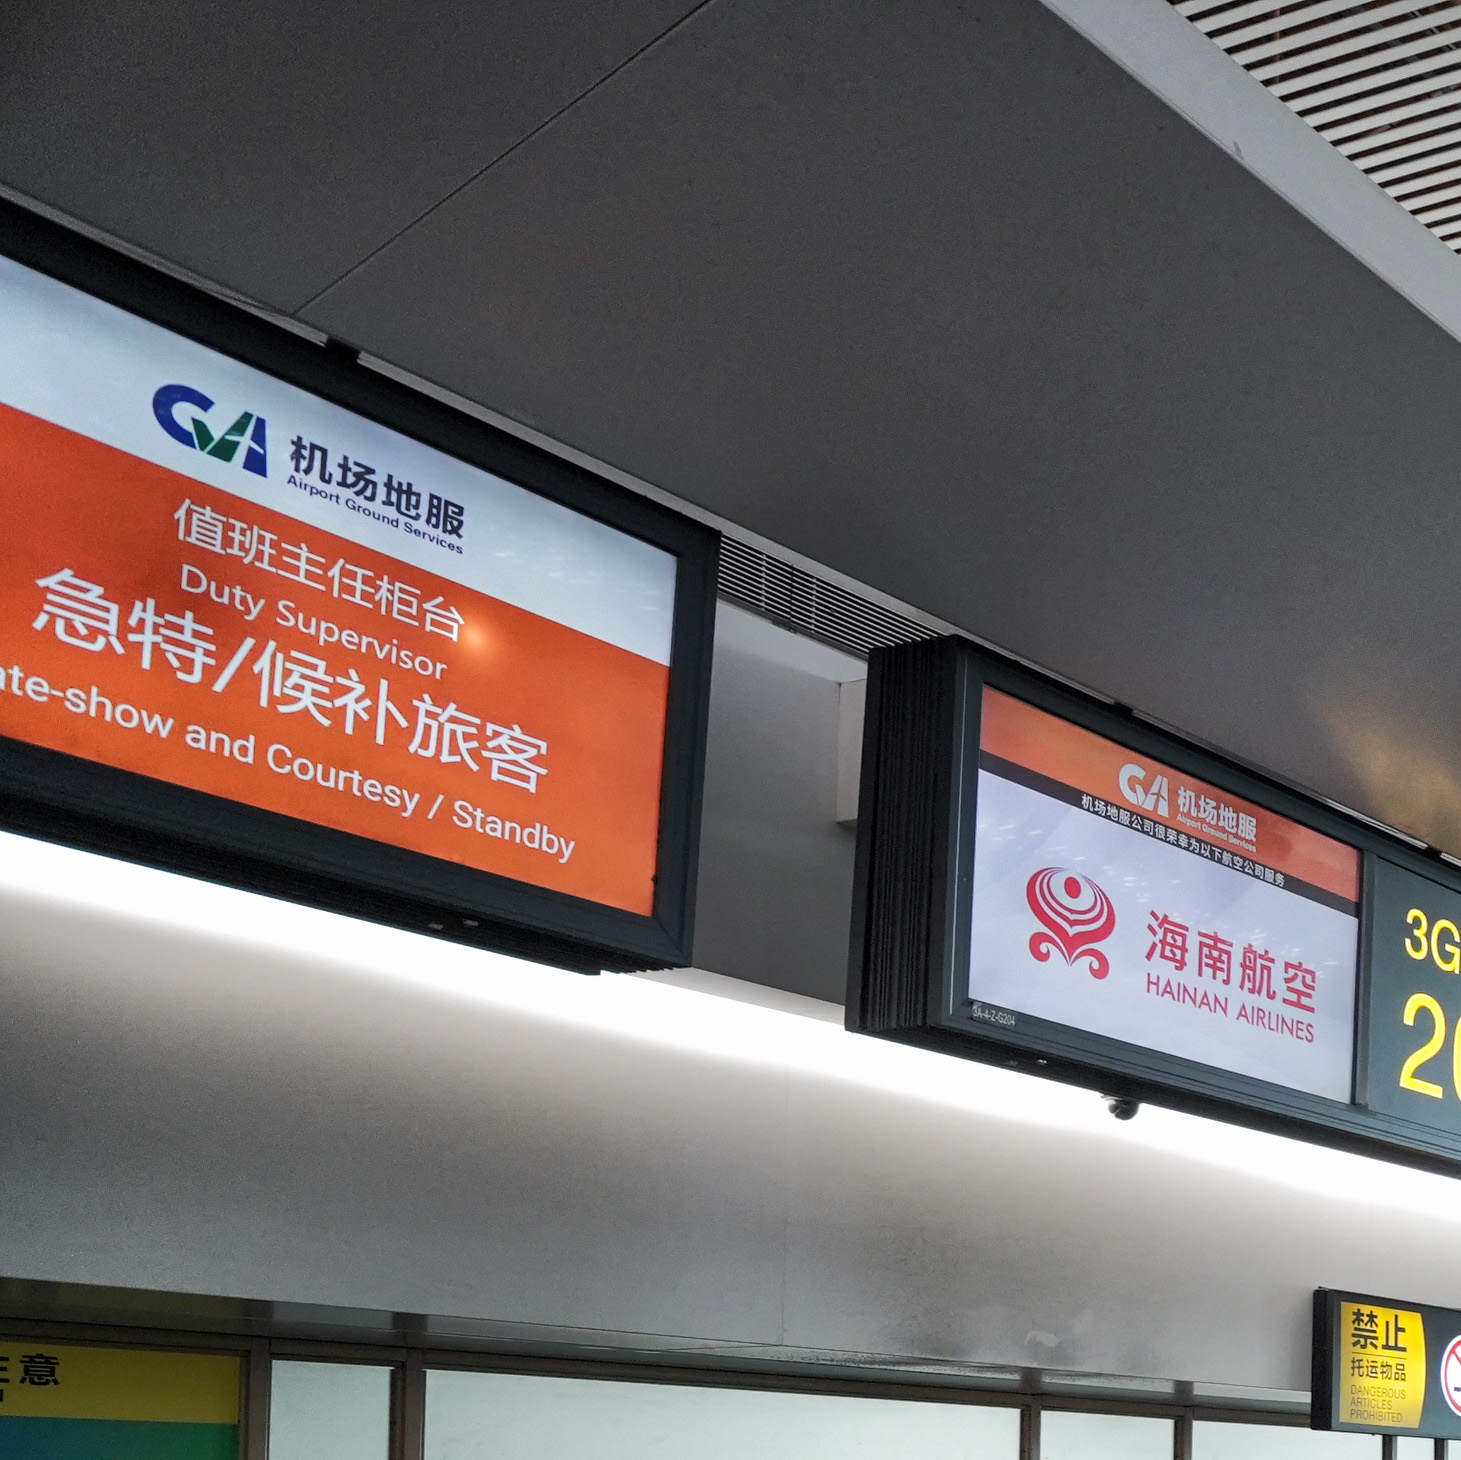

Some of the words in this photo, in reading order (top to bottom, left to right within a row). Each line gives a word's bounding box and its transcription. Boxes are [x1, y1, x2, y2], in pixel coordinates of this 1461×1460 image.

[287, 474, 341, 505] Airport
[345, 498, 399, 529] Ground
[404, 521, 464, 555] Services
[290, 435, 465, 539] 机场地服
[174, 498, 465, 643] 值班主任柜台
[181, 563, 265, 621] Duty
[275, 599, 448, 681] Supervisor
[32, 568, 548, 793] 急特/候补旅客
[185, 723, 255, 764] and
[267, 743, 419, 818] Courtesy
[427, 795, 444, 820] /
[452, 800, 575, 863] Standby
[1177, 786, 1257, 842] 机场地服
[1081, 794, 1285, 888] 机场地服公司很荣幸为以下航空公司服务
[1177, 814, 1200, 829] Airport
[1202, 823, 1227, 841] Ground
[1229, 833, 1257, 852] Services
[1145, 910, 1316, 1013] 海南航空
[1404, 908, 1461, 975] 3G
[1146, 972, 1228, 1018] HAINAN
[1236, 1002, 1315, 1043] AIRLINES
[1351, 1308, 1407, 1353] 禁止
[0, 1353, 60, 1386] 意
[1350, 1384, 1406, 1400] DANGEROUS
[1350, 1397, 1393, 1410] ARTICLES
[1351, 1357, 1406, 1382] 托运物品
[1350, 1409, 1403, 1423] PROHIBITED
